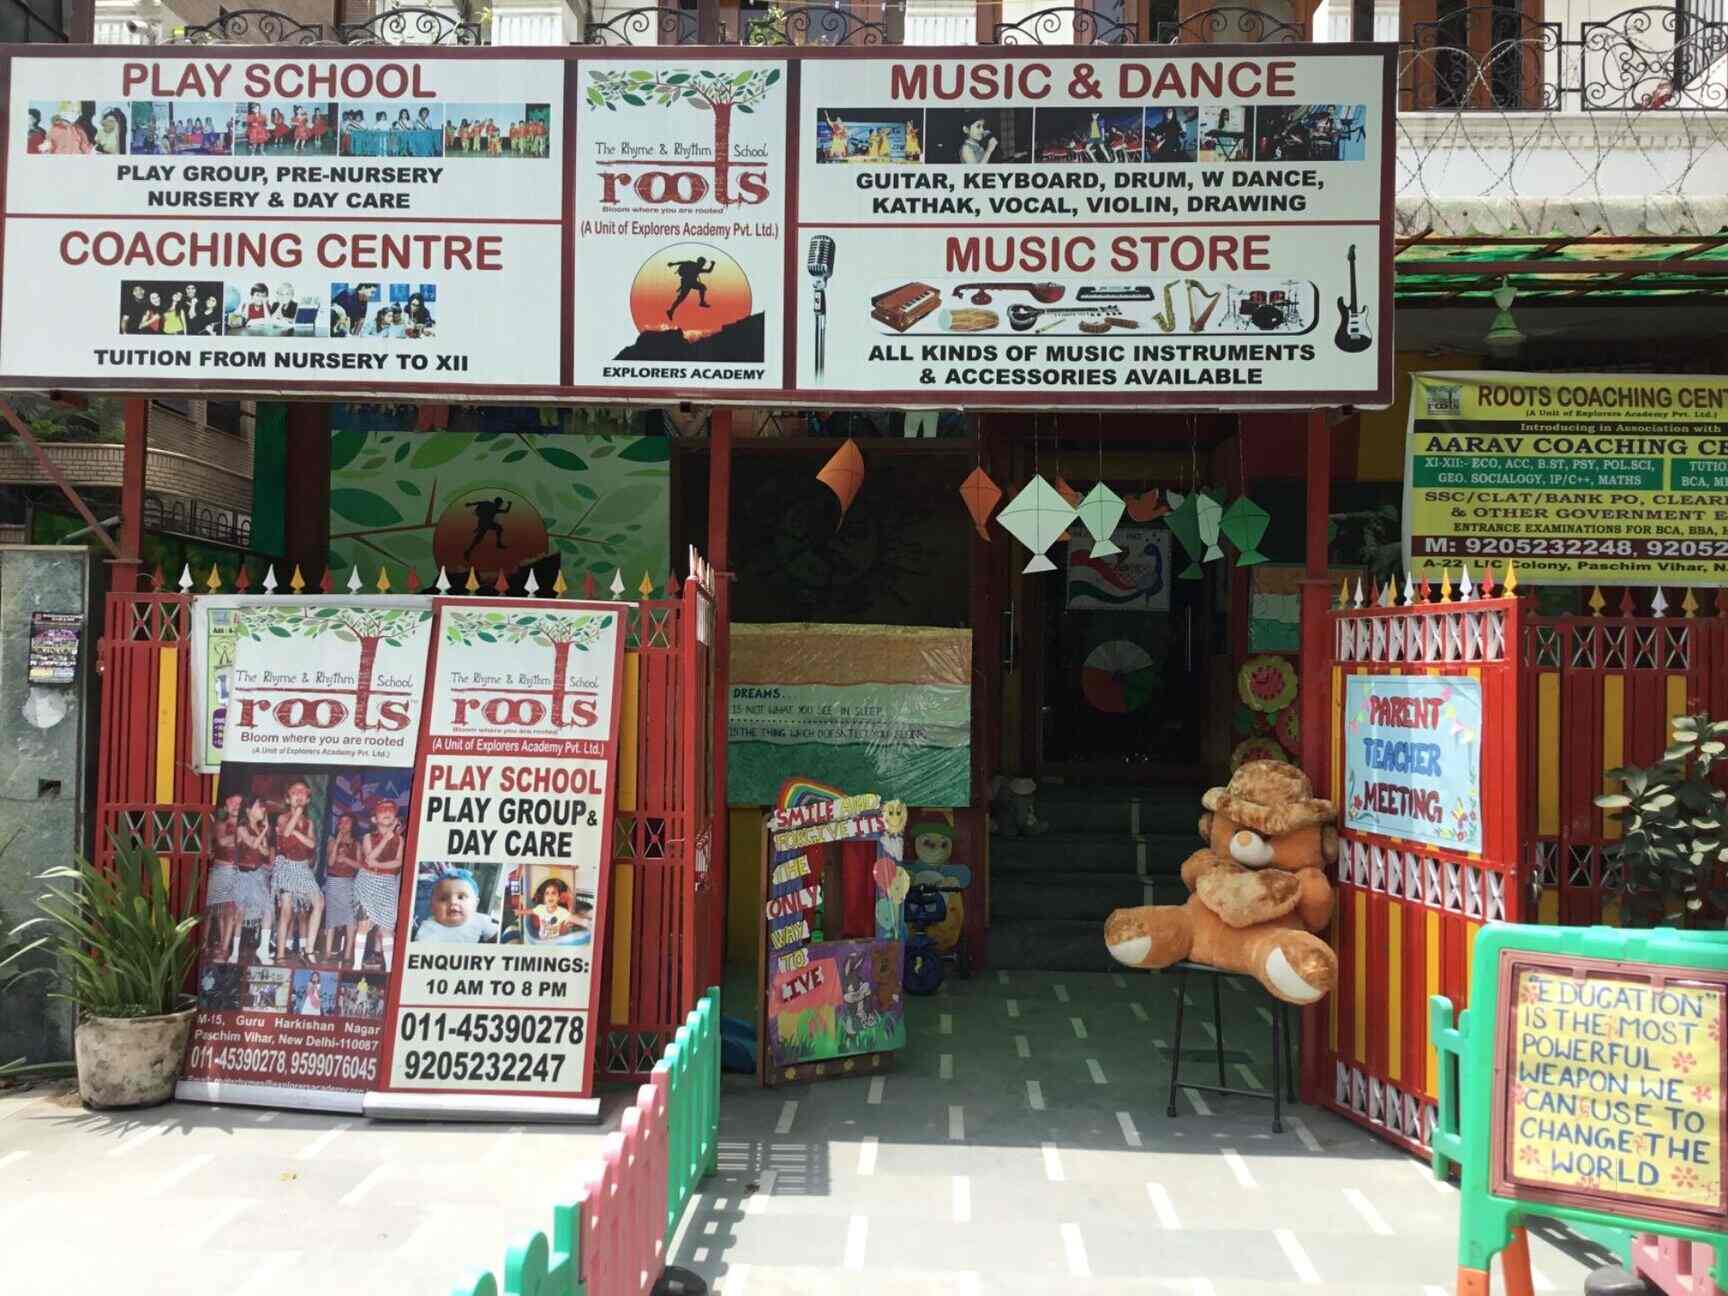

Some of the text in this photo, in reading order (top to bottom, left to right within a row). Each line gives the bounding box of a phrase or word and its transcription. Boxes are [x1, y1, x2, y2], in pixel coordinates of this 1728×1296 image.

[122, 63, 436, 99] PLAY SCHOOL
[890, 60, 1296, 100] MUSIC & DANCE
[595, 142, 768, 158] The Rhyme & Rhythm School
[117, 165, 443, 185] PLAY GROUP, PRE-NURSERY
[856, 170, 1324, 193] GUITAR, KEYBOARD, DRUM, W DANCE,
[597, 168, 770, 208] roots
[148, 191, 410, 209] NURSERY & DAY CARE
[872, 195, 1306, 217] KATHAK, VOCAL, VIOLIN, DRAWING
[581, 221, 779, 239] (A Unit of Explorers Academy Pvt. Ltd.)
[60, 230, 504, 271] COACHING CENTRE
[946, 234, 1271, 273] MUSIC STORE
[94, 350, 468, 372] TUITION FROM NURSERY TO XII
[868, 344, 1316, 361] ALL KINDS OF MUSIC INSTRUMENTS
[603, 366, 764, 380] EXPLORERS ACADEMY
[919, 367, 1263, 385] & ACCESSORIES AVAILABLE
[1478, 386, 1673, 408] ROOTS COACHING
[1520, 424, 1722, 434] Introducing in Association with
[1426, 436, 1688, 455] AARAV COACHING
[1506, 459, 1534, 470] ACC,
[1573, 459, 1600, 472] PSY,
[1471, 474, 1546, 485] SOCIALOGY,
[1599, 475, 1642, 486] MATHS
[1681, 476, 1711, 488] BCA,
[1425, 491, 1645, 506] SSC/CLAT/BANK PO,
[1451, 507, 1706, 521] & OTHER GOVERNMENT
[1454, 523, 1520, 533] ENTRANCE
[1526, 524, 1622, 534] EXAMINATIONS
[1626, 525, 1651, 534] FOR
[1656, 526, 1684, 536] BCA,
[1689, 526, 1718, 537] BBA,
[1425, 537, 1728, 557] M: 9205232248, 92052
[1474, 560, 1707, 573] LIC Colony, Paschim Vihar,
[236, 670, 413, 688] The Rhyme & Rhythm School
[235, 693, 412, 732] roots
[451, 693, 598, 728] roots
[1369, 695, 1443, 730] PARENT
[241, 732, 404, 747] Bloom where you are rooted
[1363, 738, 1442, 777] TEACHER
[429, 765, 602, 795] PLAY SCHOOL
[426, 797, 598, 826] PLAY GROUP &
[775, 800, 833, 827] SMILE
[1363, 781, 1443, 824] MEETING
[852, 815, 886, 837] ITS
[448, 830, 572, 858] DAY CARE
[767, 885, 821, 918] ONLY
[770, 921, 805, 950] WAY
[408, 954, 589, 974] ENQUIRY TIMINGS:
[780, 947, 807, 972] TO
[425, 979, 567, 998] 10 AM TO 8 PM
[782, 966, 823, 1003] LIVE
[197, 1014, 381, 1035] M-15, Guru Harkishan Nagar
[401, 1012, 584, 1045] 011-45390278
[1524, 1007, 1699, 1046] IS THE MOST
[194, 1029, 379, 1051] Paschim Vihar, New Delhi-110087
[1521, 1032, 1661, 1072] POWERFUL
[290, 1051, 376, 1081] 9599076045
[405, 1050, 566, 1083] 9205232247
[1519, 1061, 1684, 1104] WEAPON WE
[1523, 1088, 1705, 1134] CAN USE TO
[1519, 1116, 1711, 1165] CHANGE THE
[1551, 1149, 1660, 1187] WORLD
